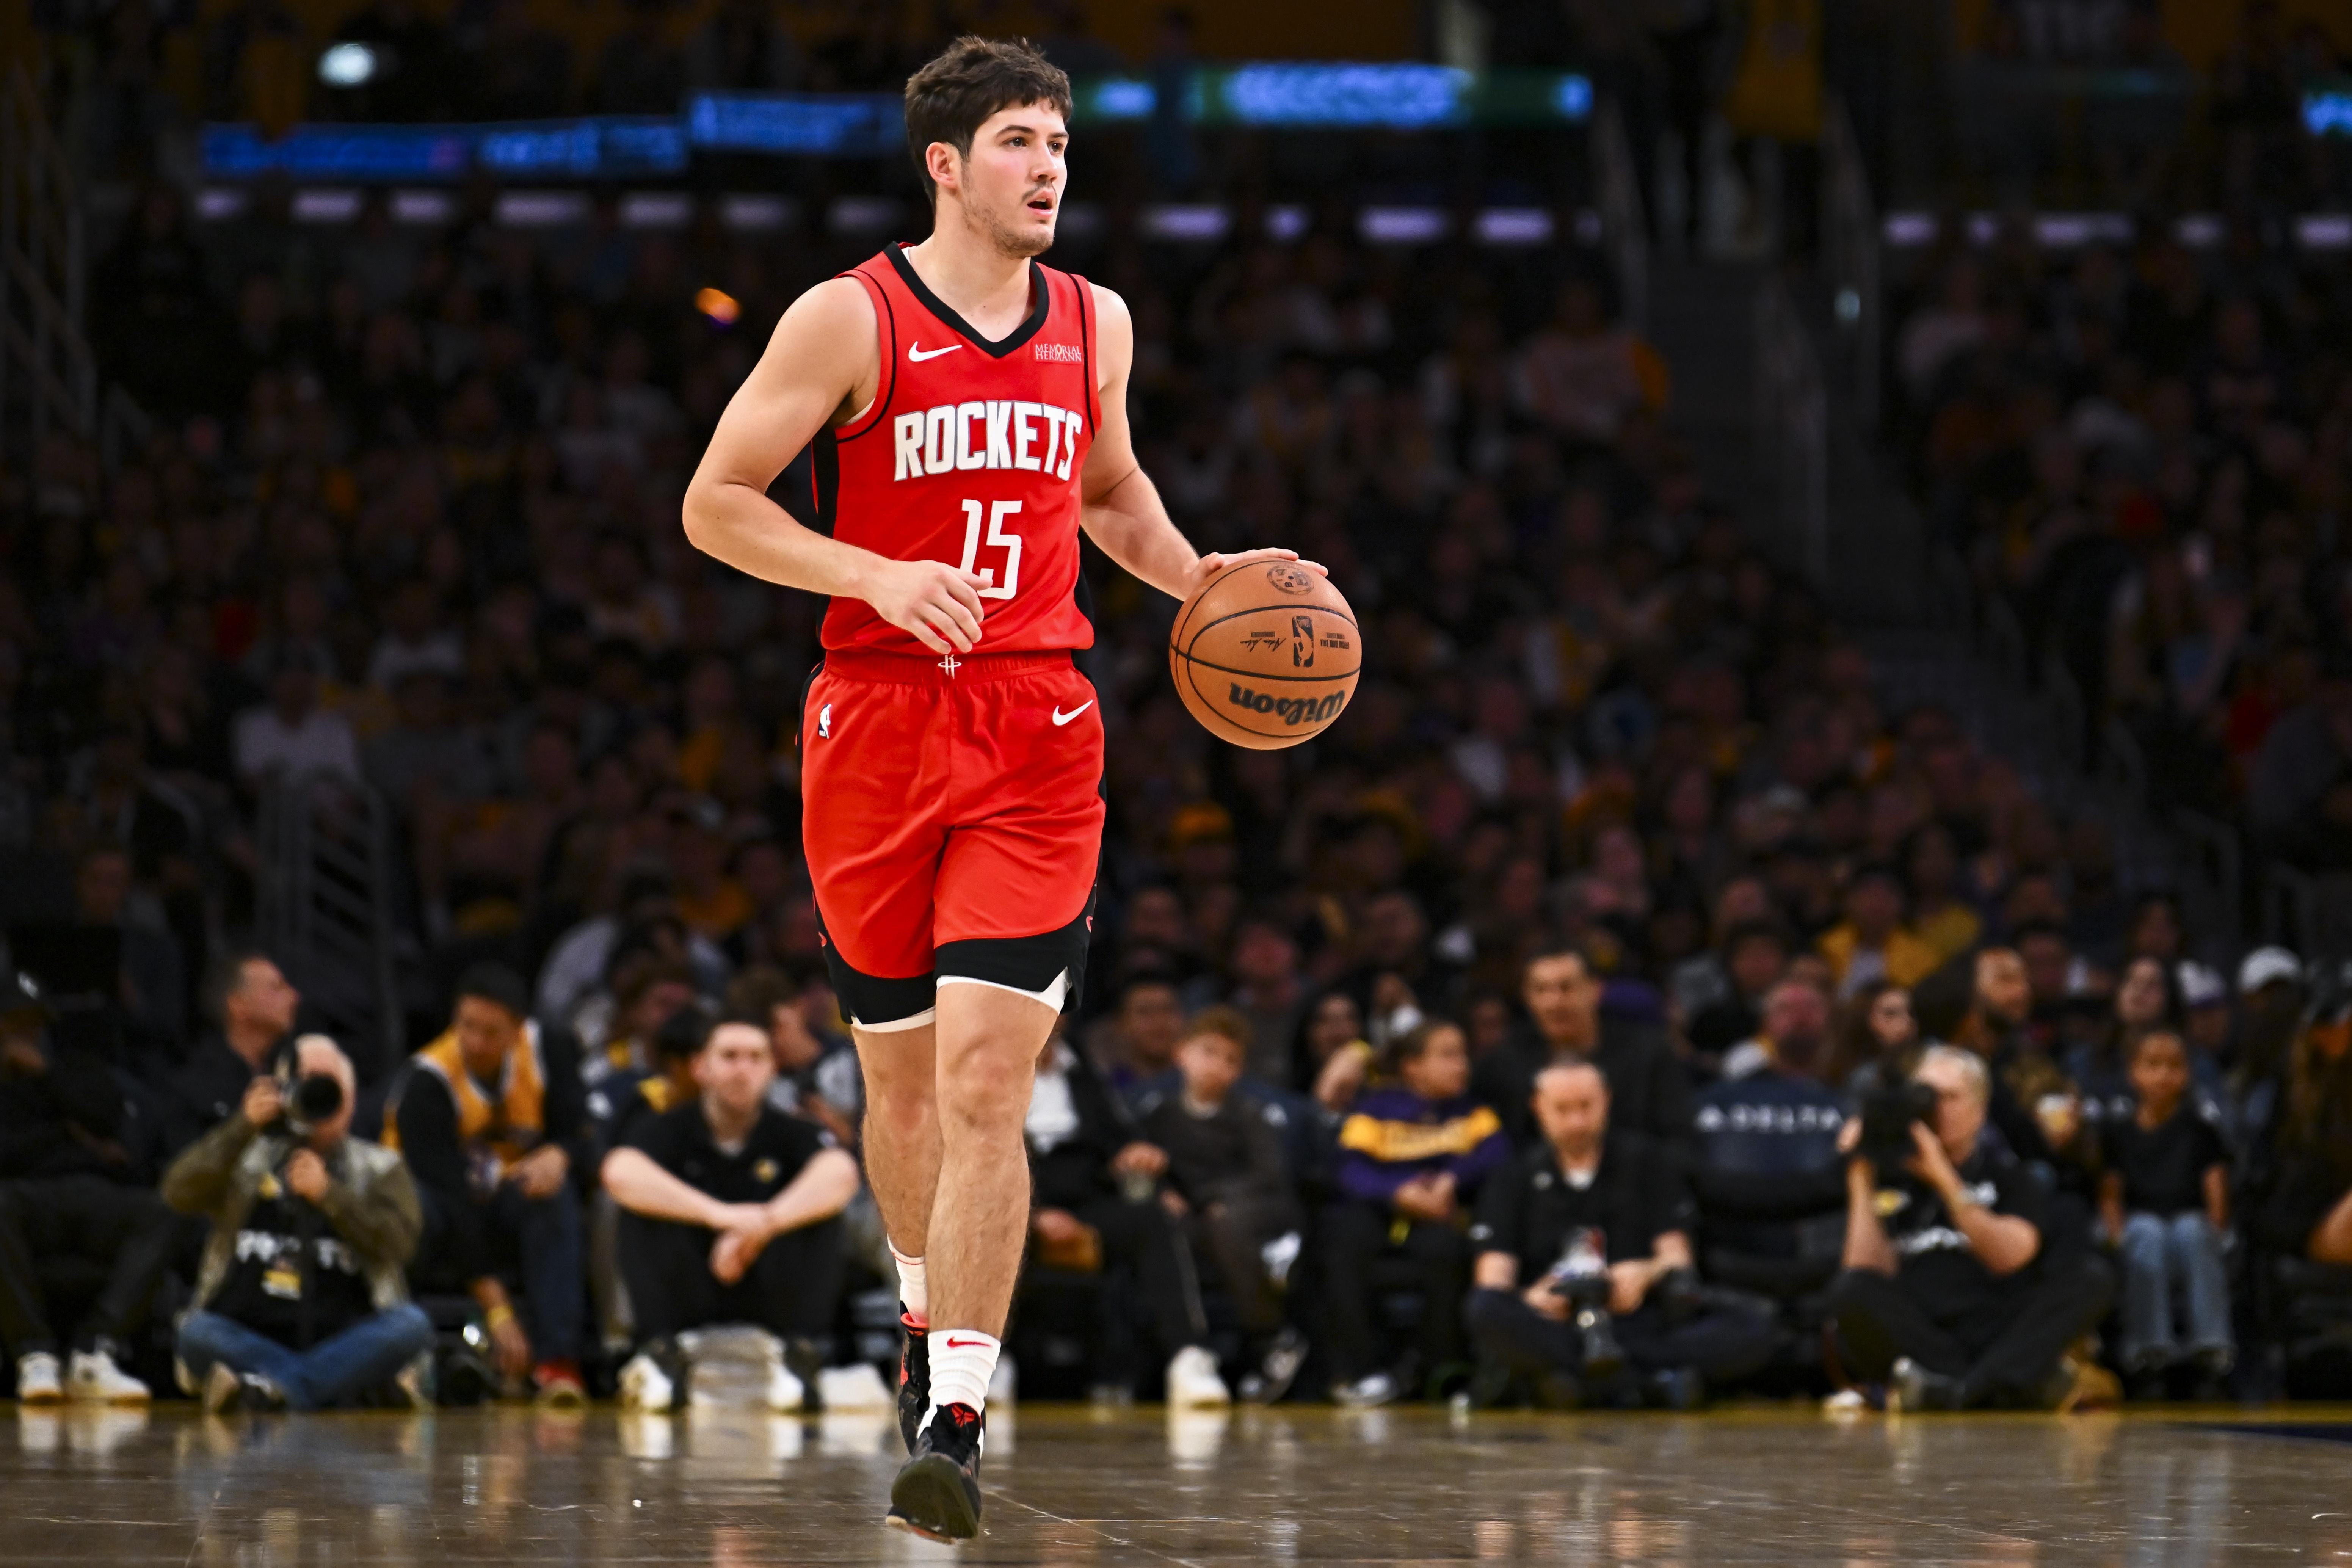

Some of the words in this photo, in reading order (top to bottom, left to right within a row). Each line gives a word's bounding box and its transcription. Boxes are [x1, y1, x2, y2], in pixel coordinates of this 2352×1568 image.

[1035, 343, 1081, 354] MEMORIAL
[1036, 351, 1082, 361] HERMANN
[894, 400, 1082, 481] ROCKETS
[959, 499, 1022, 600] 15
[1229, 682, 1345, 725] Wilson
